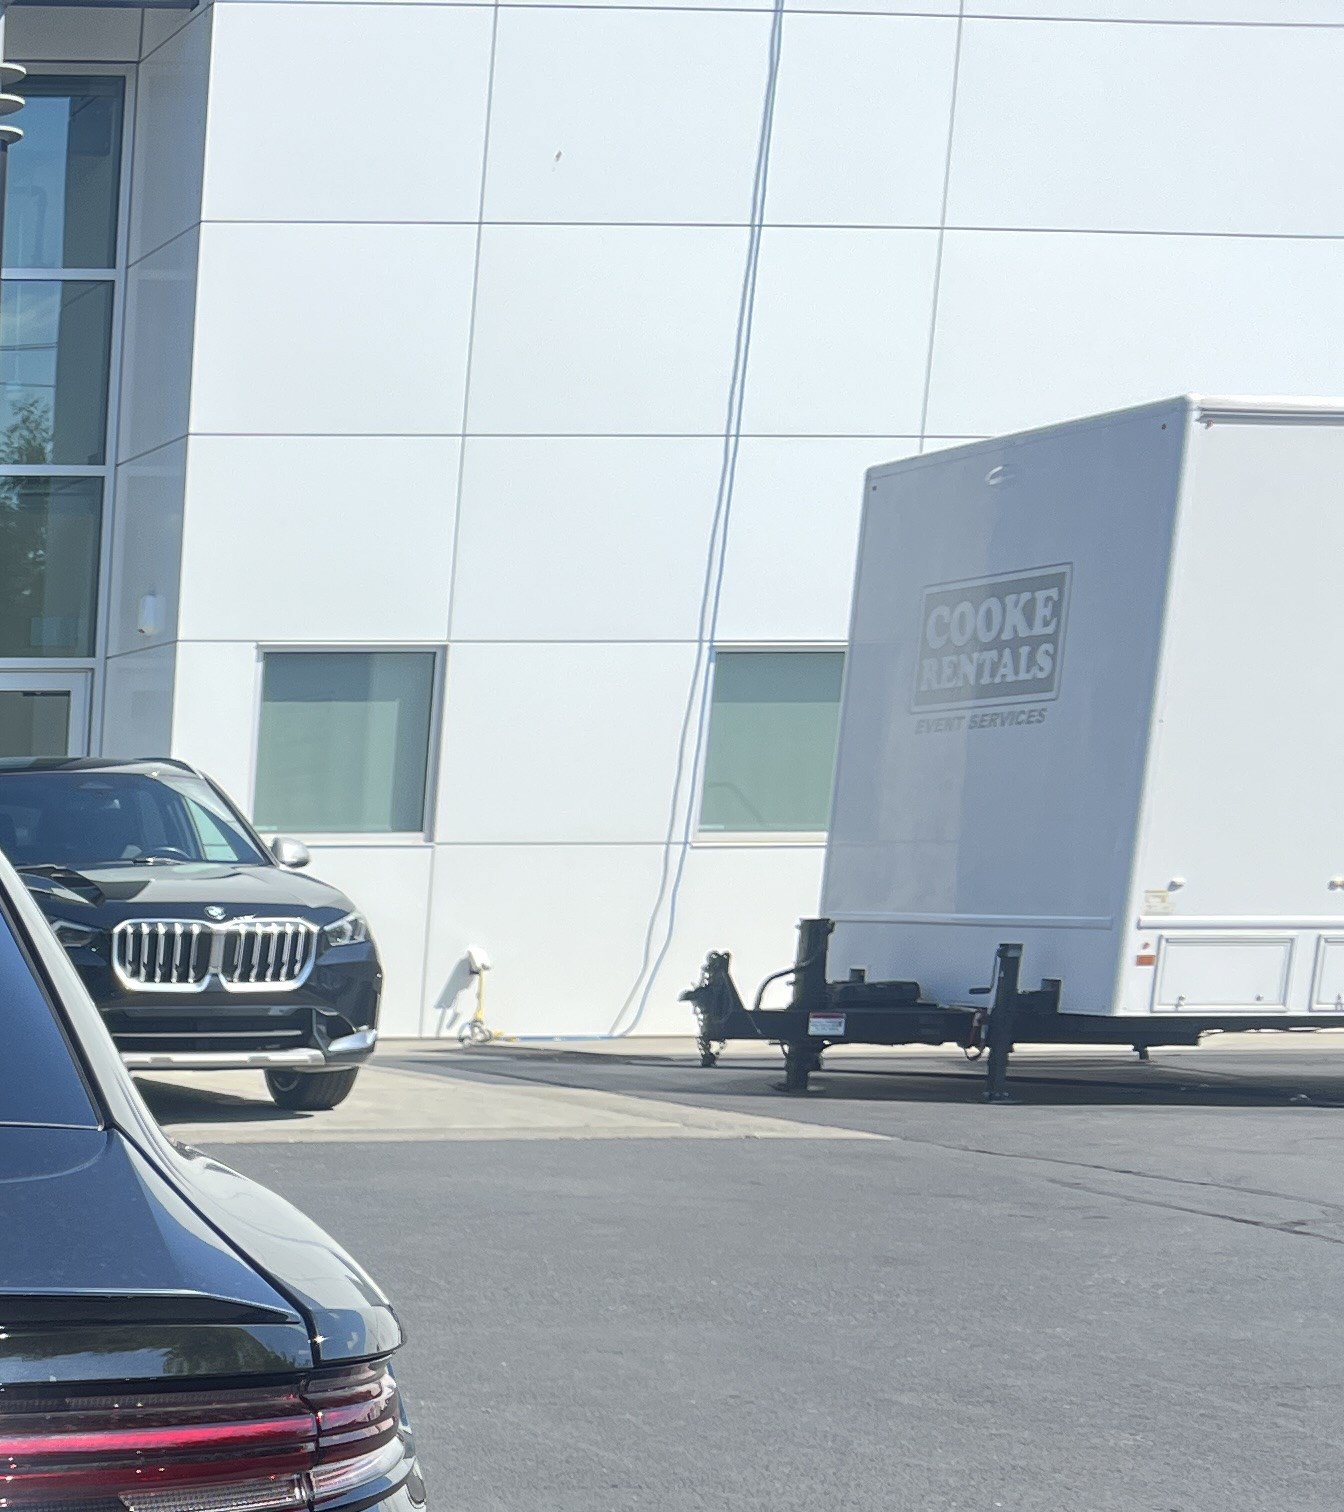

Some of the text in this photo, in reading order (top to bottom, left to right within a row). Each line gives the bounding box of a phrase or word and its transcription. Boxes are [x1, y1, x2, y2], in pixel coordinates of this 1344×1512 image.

[926, 588, 1060, 650] COOKE
[920, 643, 1055, 691] RENTALS
[914, 708, 1048, 735] EVENT SERVICES
